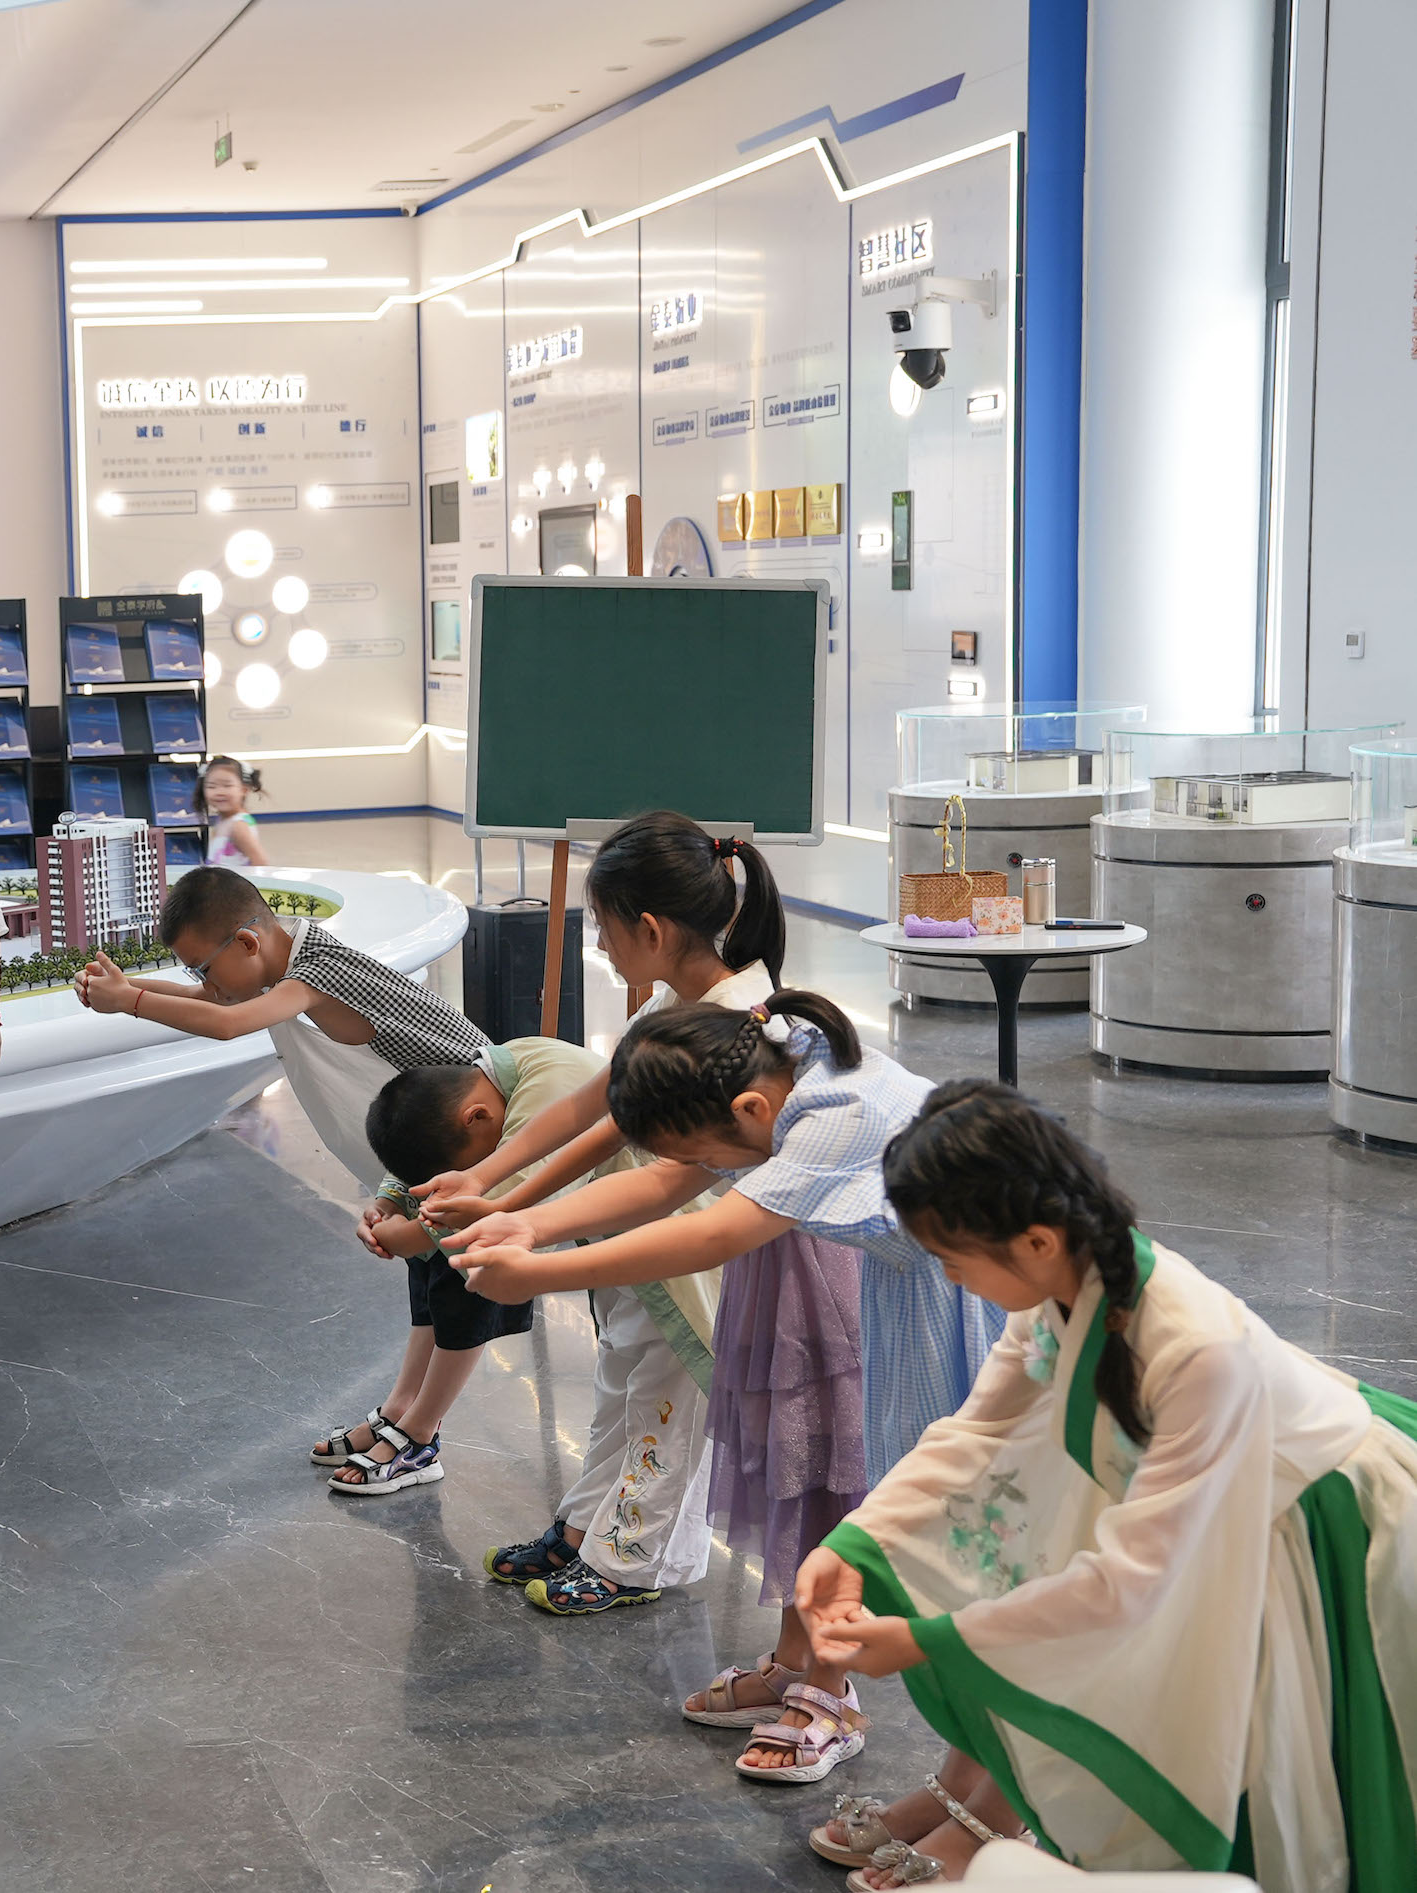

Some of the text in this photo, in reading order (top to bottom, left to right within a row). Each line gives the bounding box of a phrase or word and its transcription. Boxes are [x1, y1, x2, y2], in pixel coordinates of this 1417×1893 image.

[862, 281, 886, 297] SMART
[229, 405, 282, 416] MORALITY
[323, 402, 348, 412] LINE
